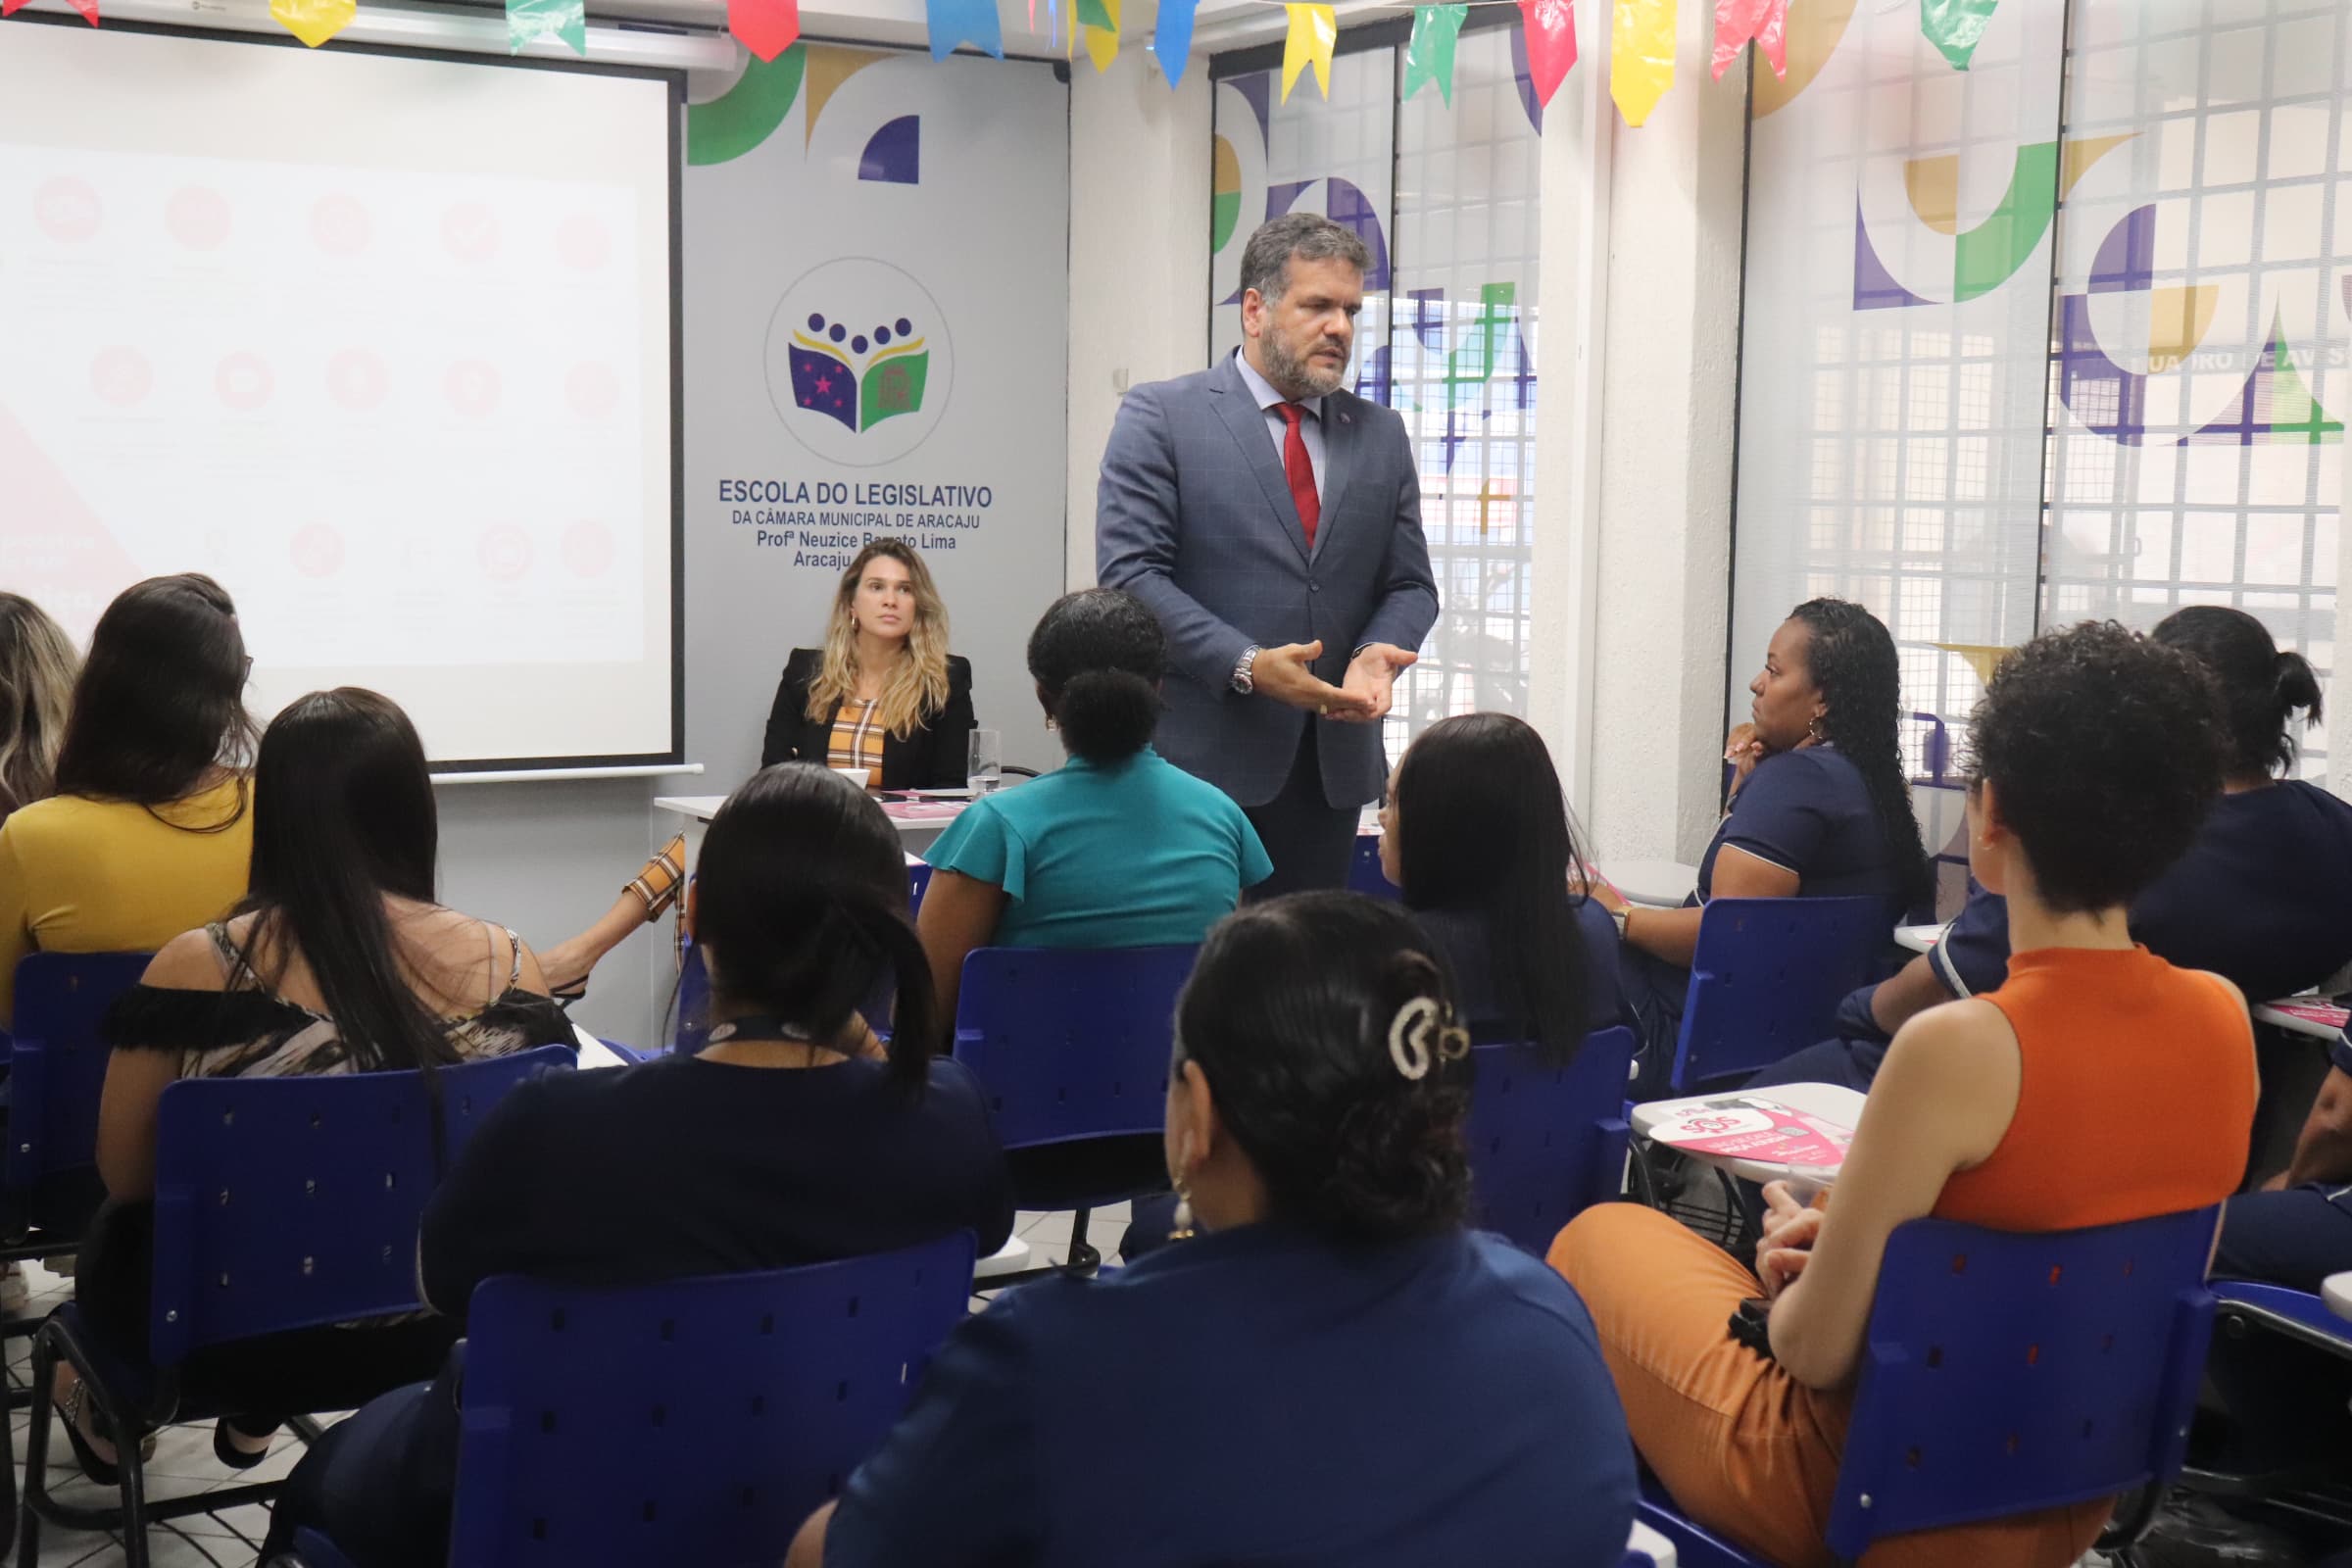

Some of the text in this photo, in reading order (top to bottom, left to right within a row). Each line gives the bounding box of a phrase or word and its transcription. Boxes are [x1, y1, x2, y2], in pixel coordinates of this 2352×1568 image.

[719, 479, 992, 508] ESCOLA DO LEGISLATIVO
[732, 508, 980, 529] DA CÂMARA MUNICIPAL DE ARACAJU
[800, 531, 858, 548] Neuzice
[921, 533, 956, 549] Lima
[794, 550, 851, 571] Aracaju
